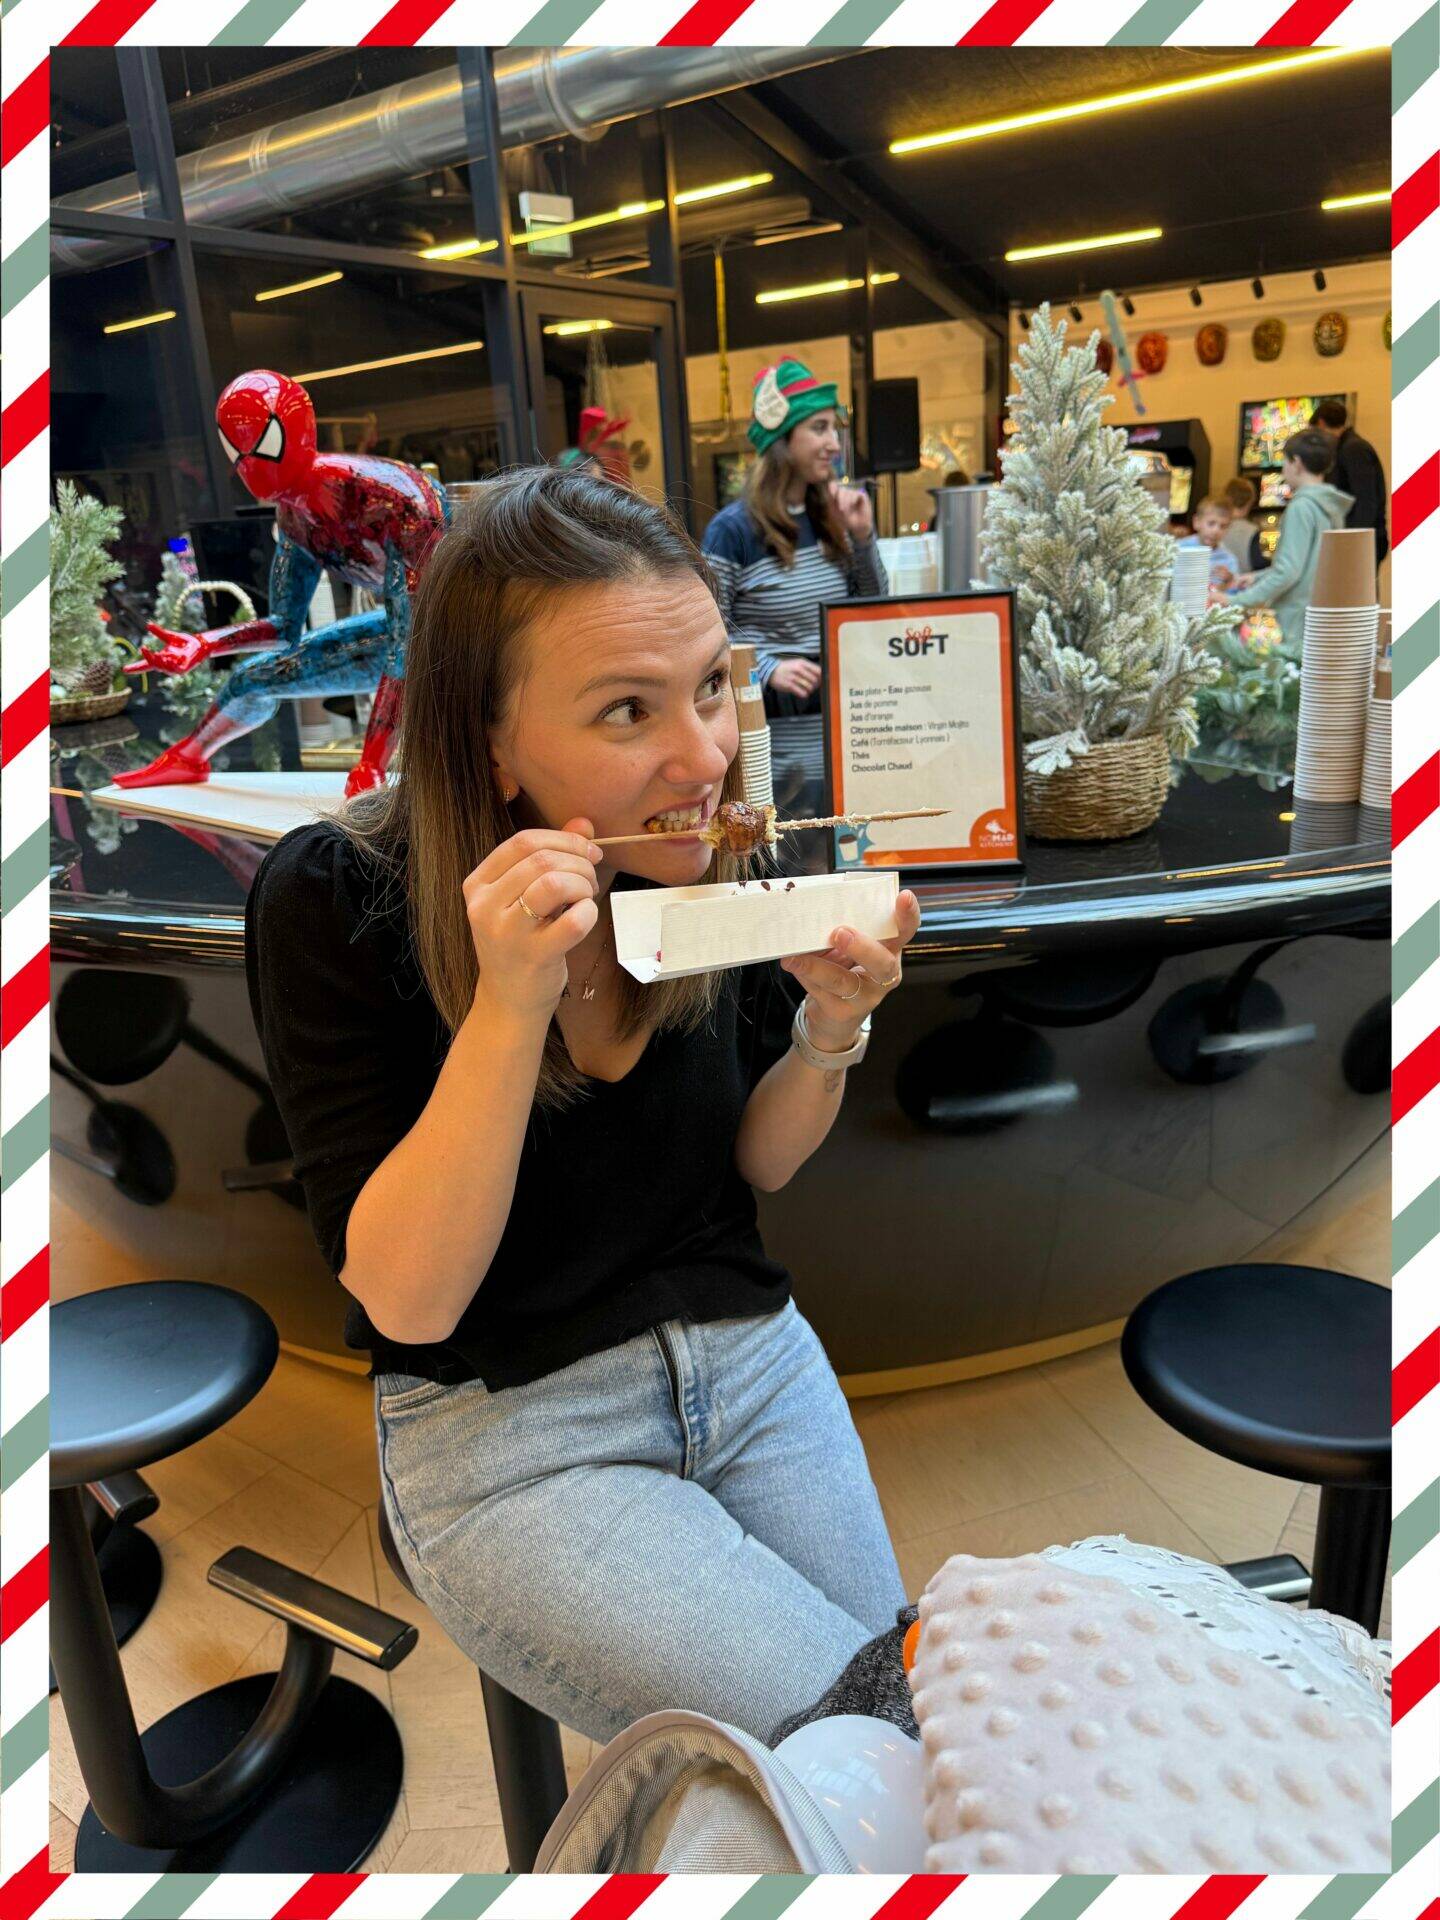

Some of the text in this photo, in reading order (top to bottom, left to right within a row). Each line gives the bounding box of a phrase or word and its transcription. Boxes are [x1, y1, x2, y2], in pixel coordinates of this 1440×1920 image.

[888, 633, 949, 657] SOFT
[849, 688, 864, 697] Eau
[888, 685, 903, 694] Eau
[849, 700, 862, 709] Jus
[864, 700, 872, 708] de
[850, 713, 863, 722] Jus
[850, 724, 893, 735] Citronnade
[894, 723, 922, 732] maison
[927, 721, 947, 731] Virgin
[948, 720, 969, 729] Mojito
[851, 738, 869, 747] Café
[851, 751, 870, 760] Thés
[851, 761, 913, 773] Chocolat Chaud
